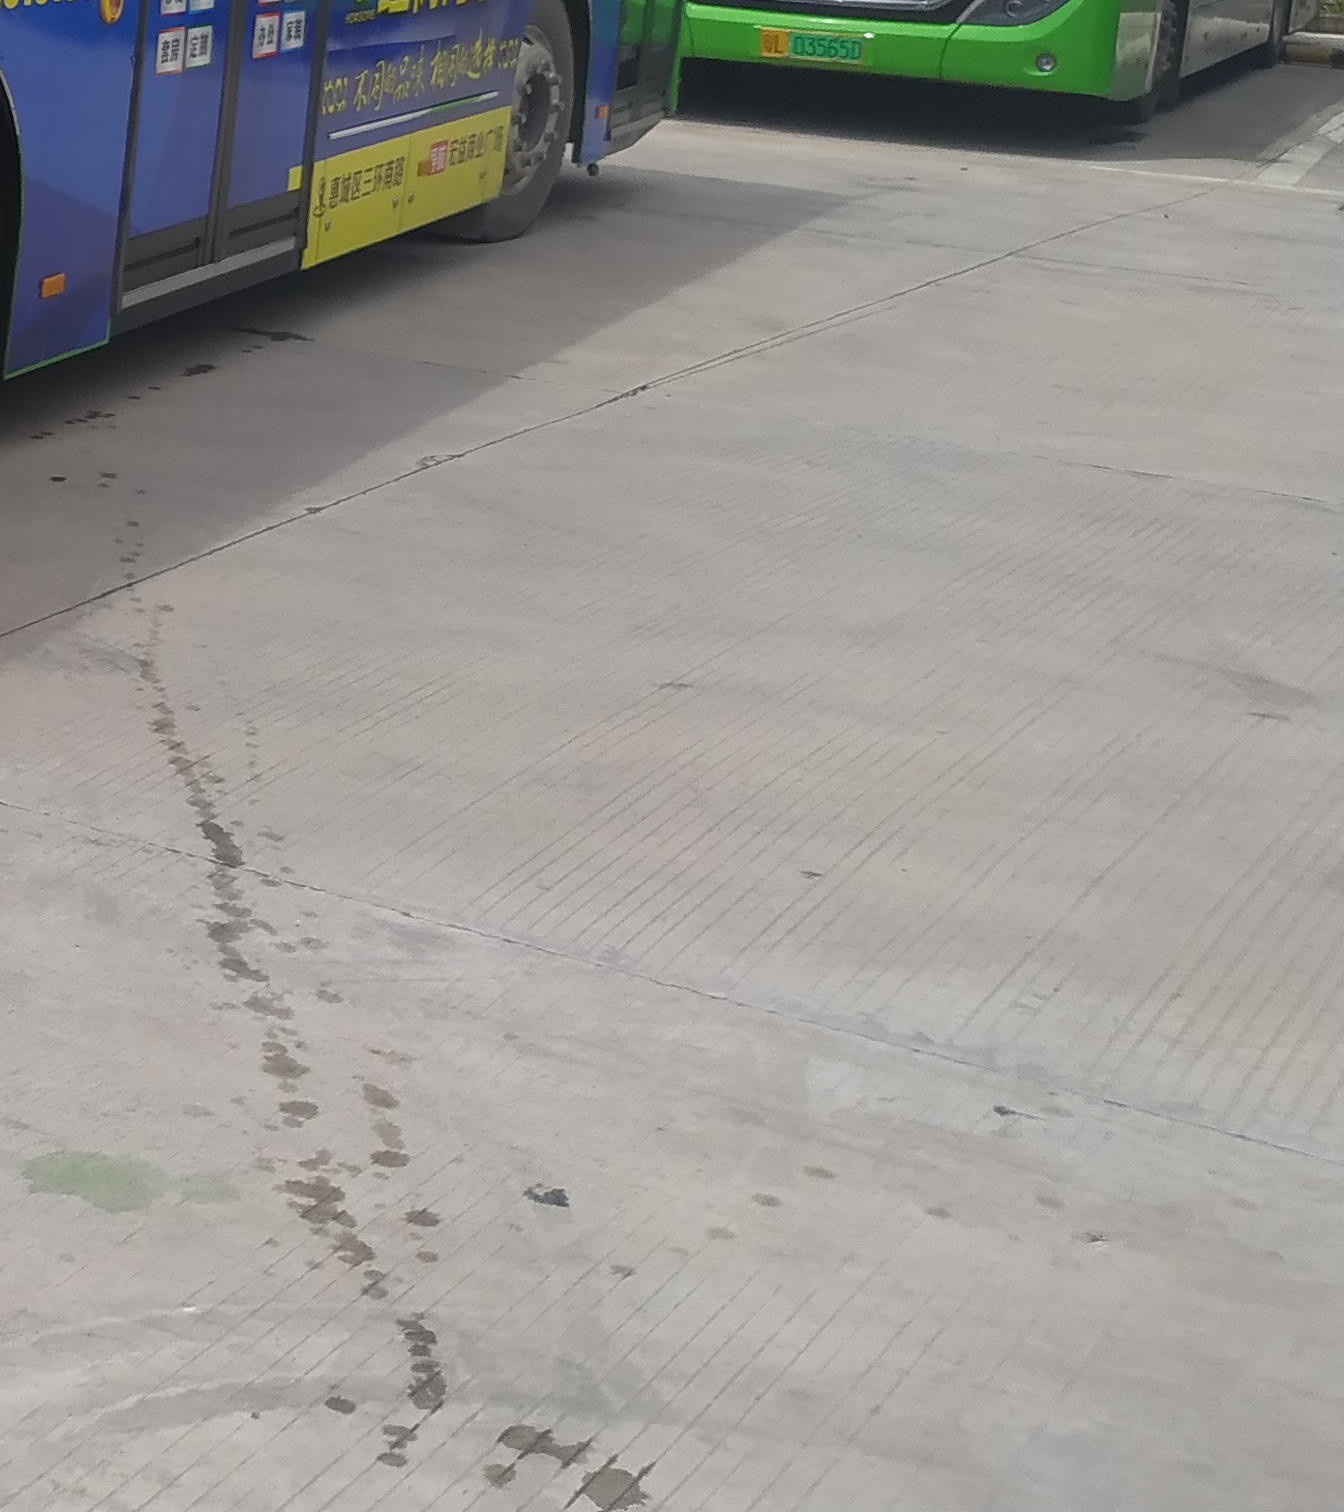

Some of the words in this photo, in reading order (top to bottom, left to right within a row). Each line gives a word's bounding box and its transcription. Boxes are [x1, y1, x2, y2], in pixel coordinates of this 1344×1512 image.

[329, 155, 405, 209] 惠城区三环南路
